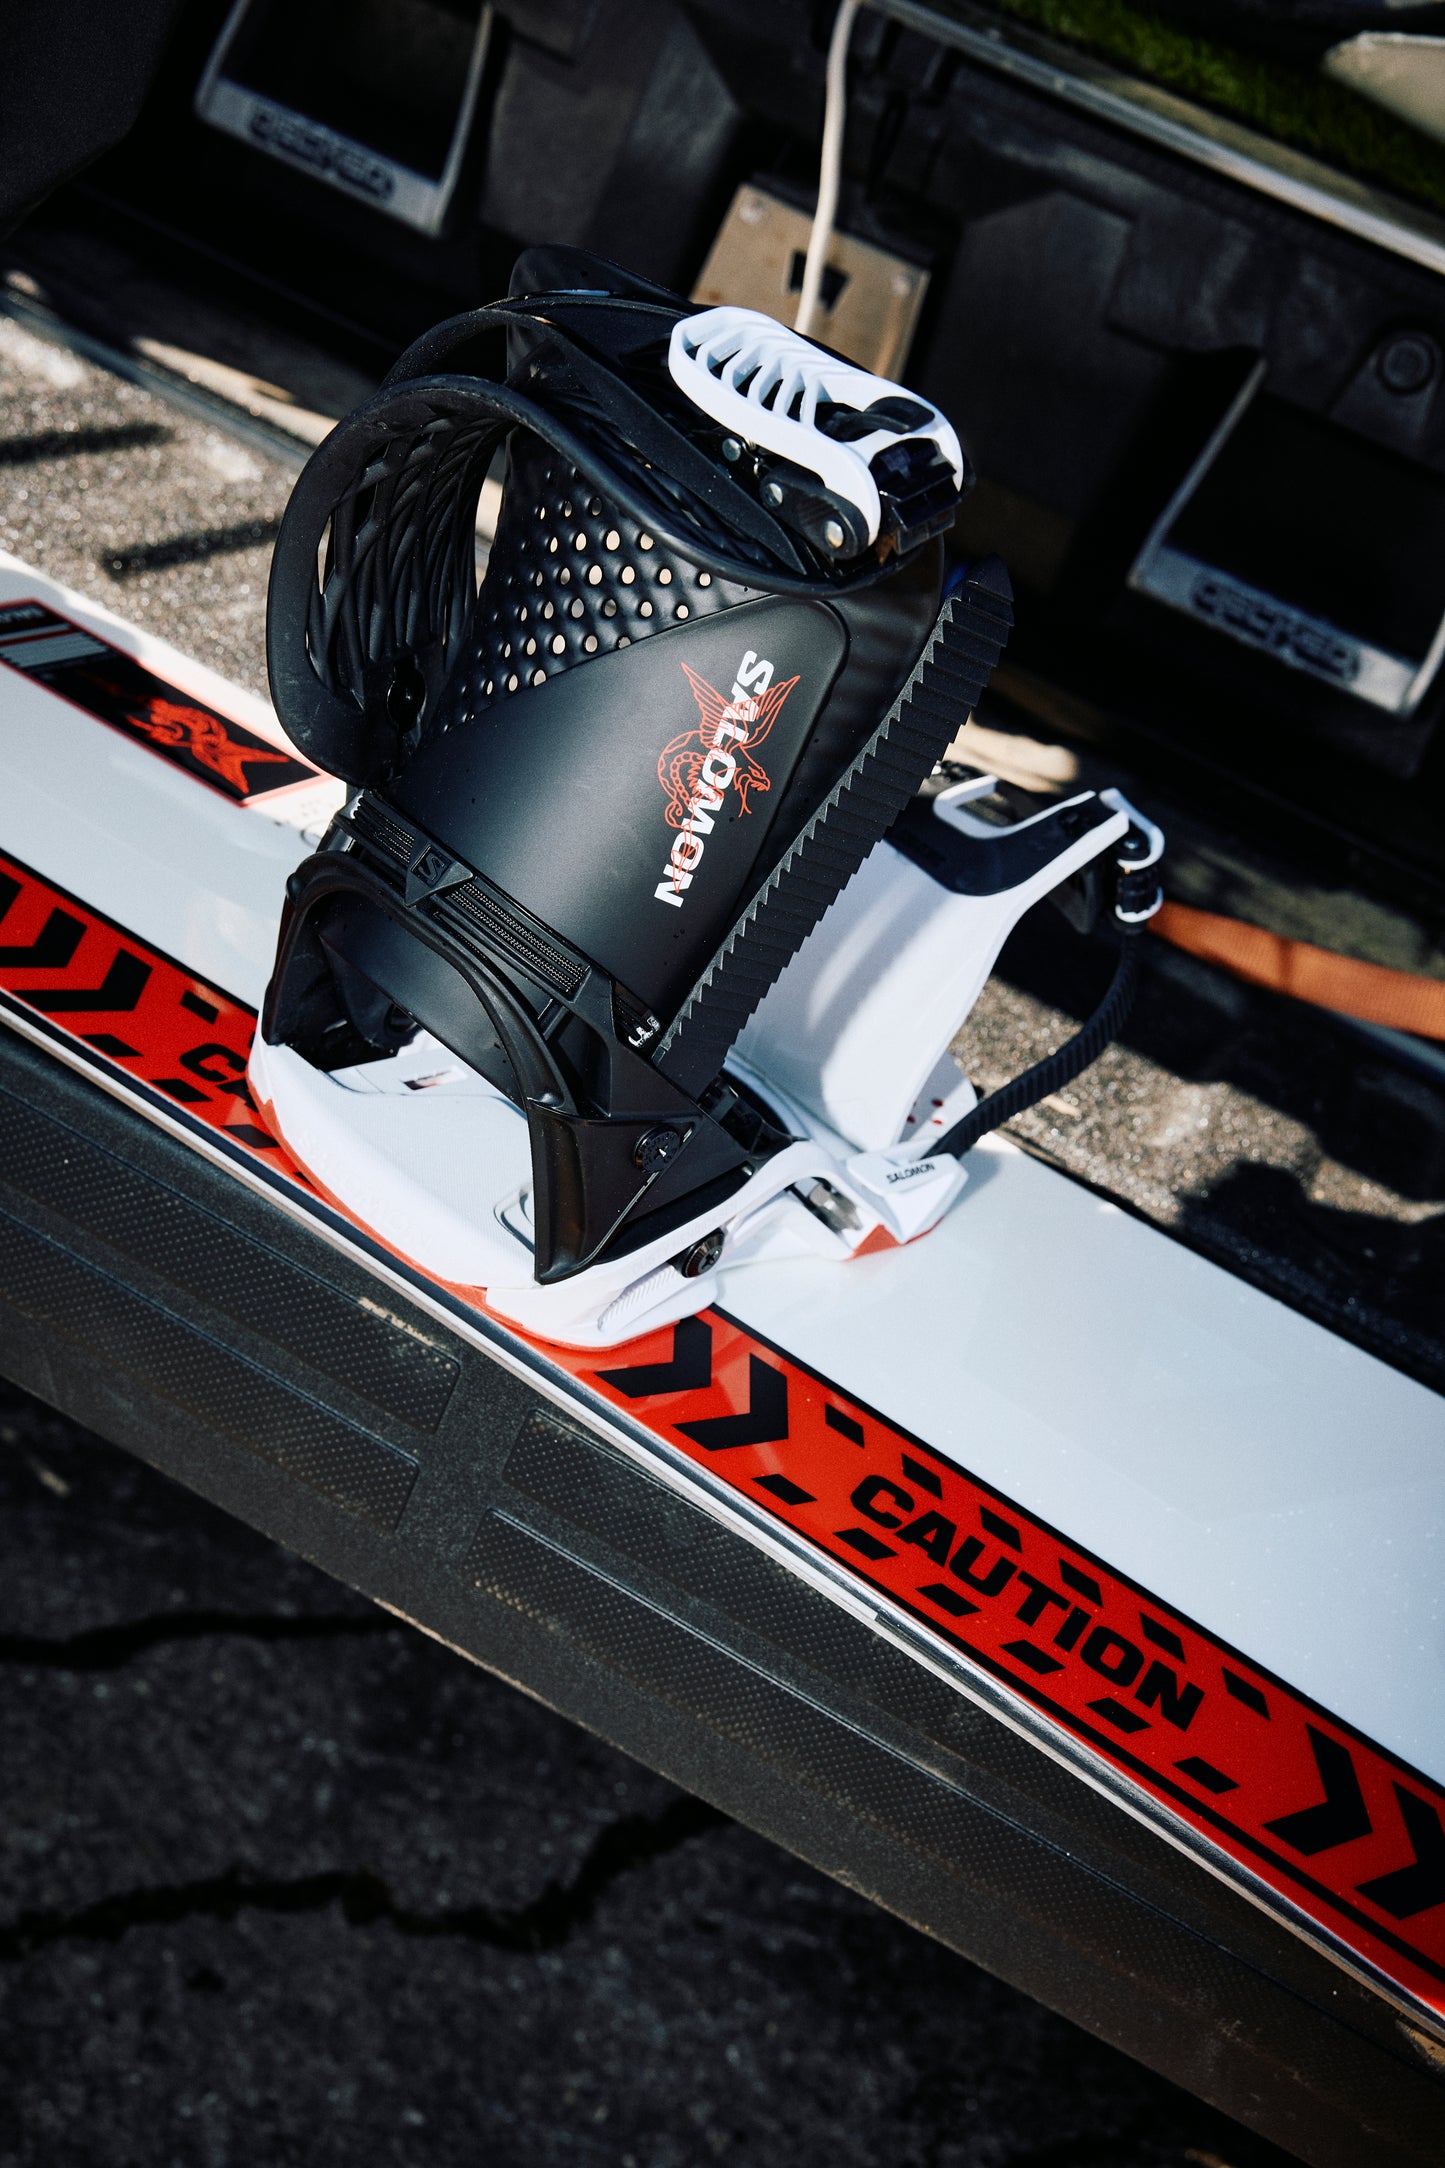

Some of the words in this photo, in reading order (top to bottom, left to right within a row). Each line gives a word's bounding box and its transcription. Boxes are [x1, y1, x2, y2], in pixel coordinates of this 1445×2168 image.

[654, 650, 775, 908] SALOMON
[886, 1162, 935, 1184] SALOMON
[850, 1474, 1206, 1732] CAUTION
